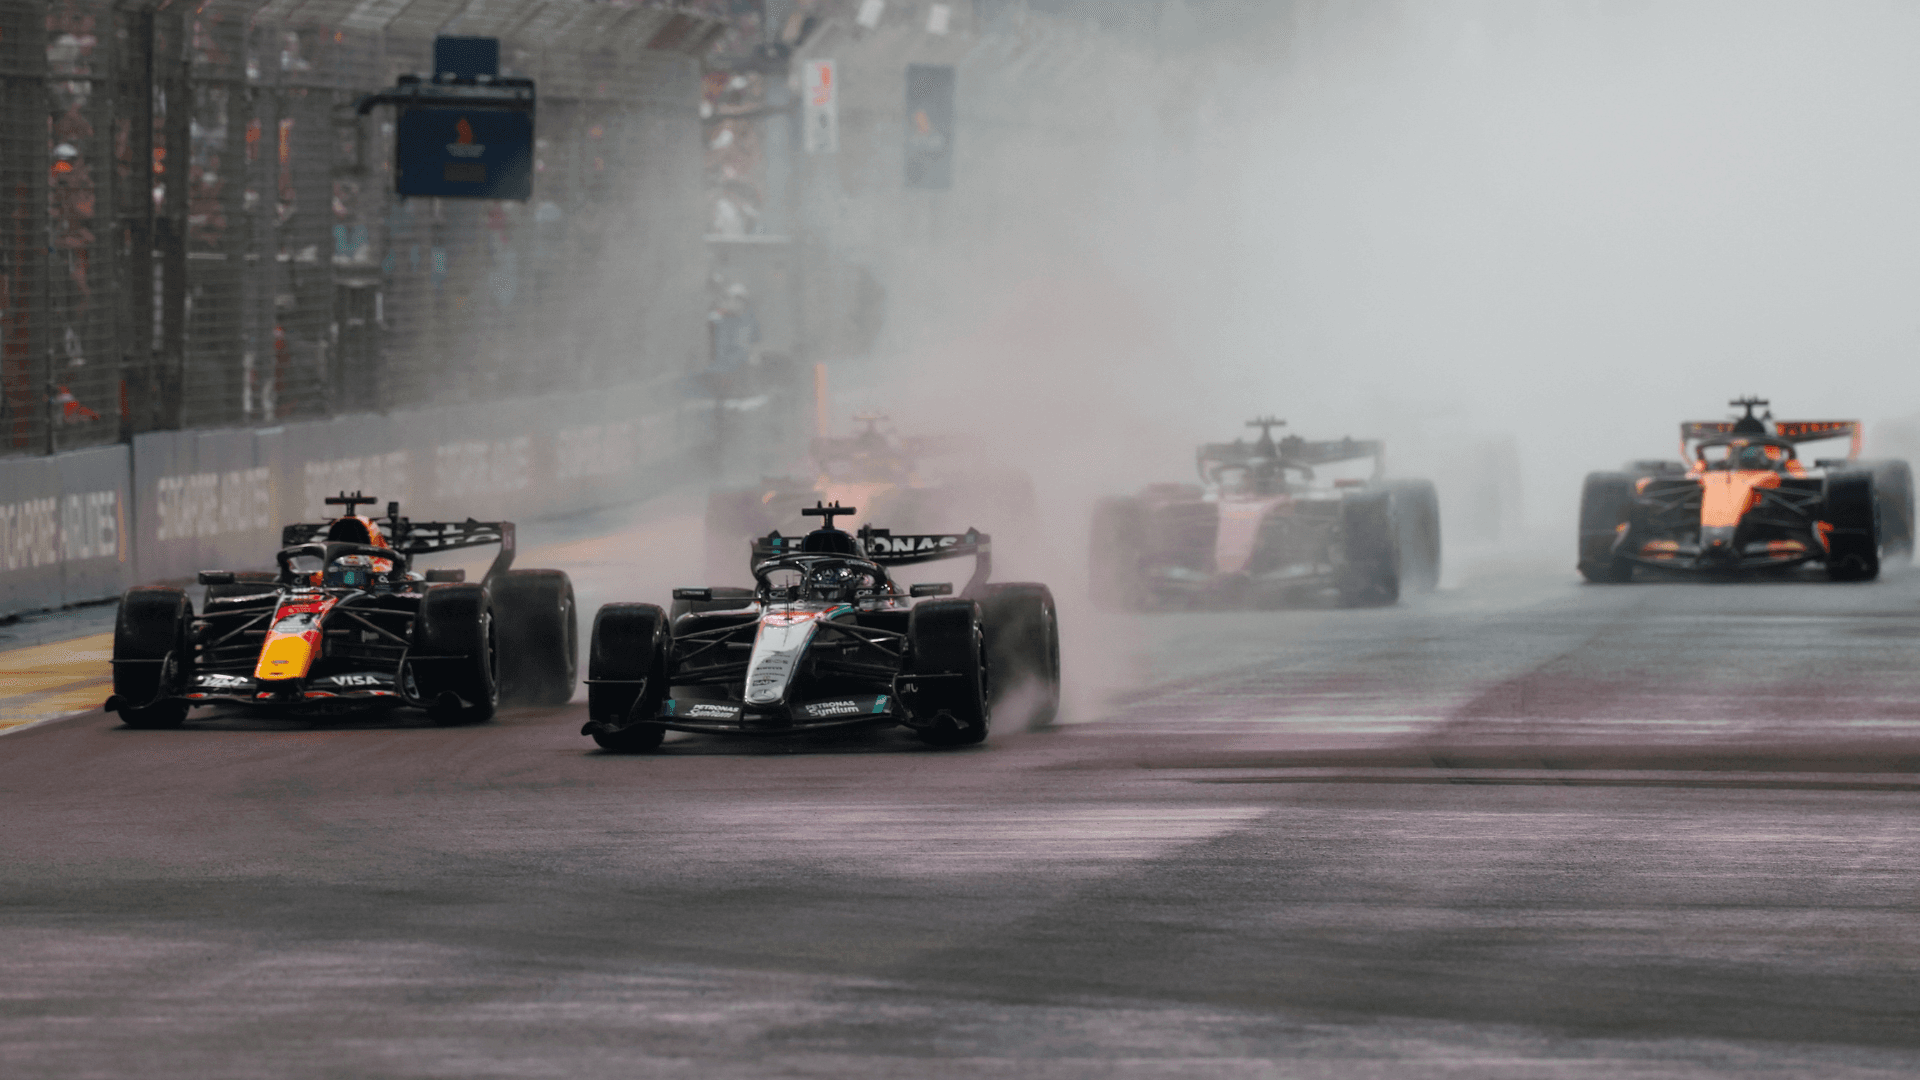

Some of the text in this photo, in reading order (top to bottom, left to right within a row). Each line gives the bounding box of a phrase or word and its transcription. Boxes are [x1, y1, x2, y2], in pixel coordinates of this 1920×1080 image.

[331, 675, 380, 686] VISA
[694, 704, 740, 712] PETRONAS
[805, 701, 856, 711] PETRONAS
[808, 706, 860, 717] Syntium
